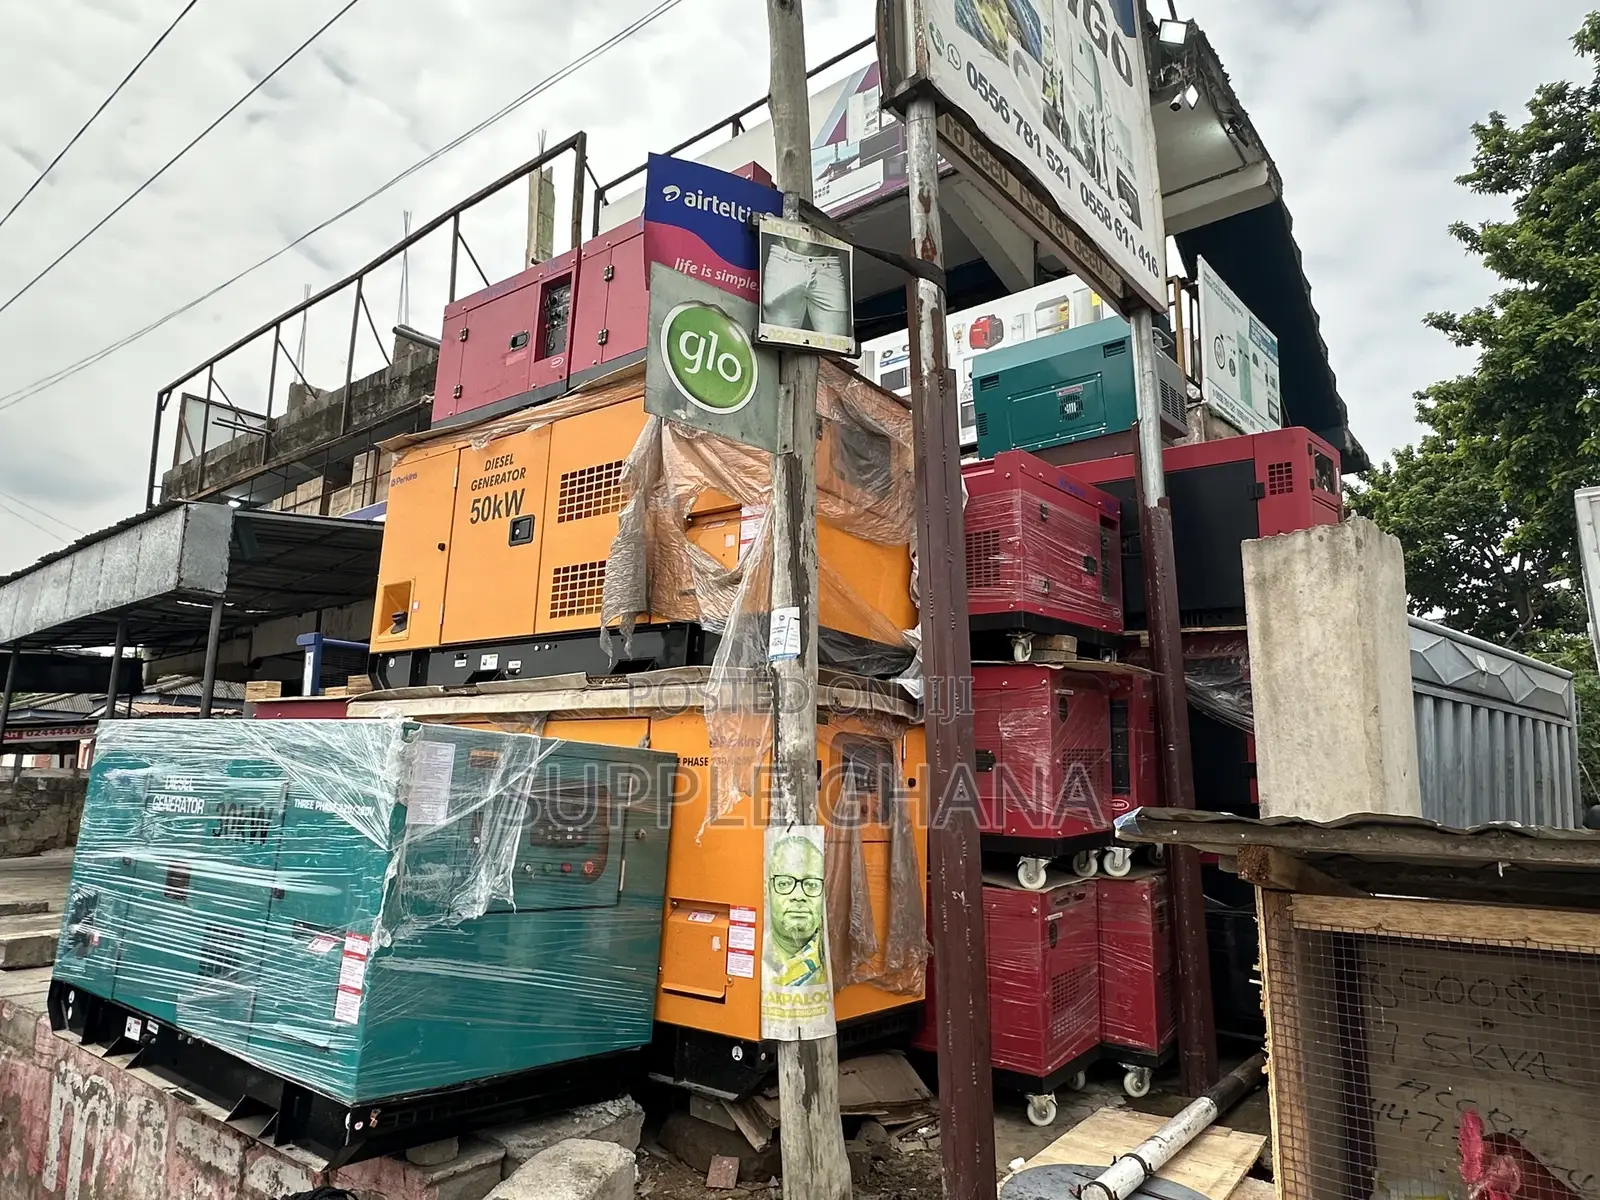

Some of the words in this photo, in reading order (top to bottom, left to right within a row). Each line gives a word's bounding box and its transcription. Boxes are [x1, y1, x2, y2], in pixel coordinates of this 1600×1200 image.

[1067, 0, 1134, 88] GO
[966, 61, 1010, 124] 0556
[1013, 109, 1041, 158] 781
[1046, 144, 1072, 189] 521
[1080, 182, 1112, 231] 0558
[1115, 218, 1136, 255] 611
[1139, 245, 1159, 278] 416
[684, 189, 775, 224] airtelti
[674, 257, 698, 277] life
[701, 264, 712, 278] is
[714, 268, 760, 291] simple.
[679, 330, 742, 382] glo
[485, 453, 514, 471] DIESEL
[471, 467, 526, 491] GENERATOR
[471, 488, 526, 524] 50kW
[26, 726, 95, 737] 024444965
[682, 757, 709, 767] PHASE
[152, 795, 205, 814] GENERATOR
[294, 799, 314, 810] THREE
[315, 800, 336, 813] PHA
